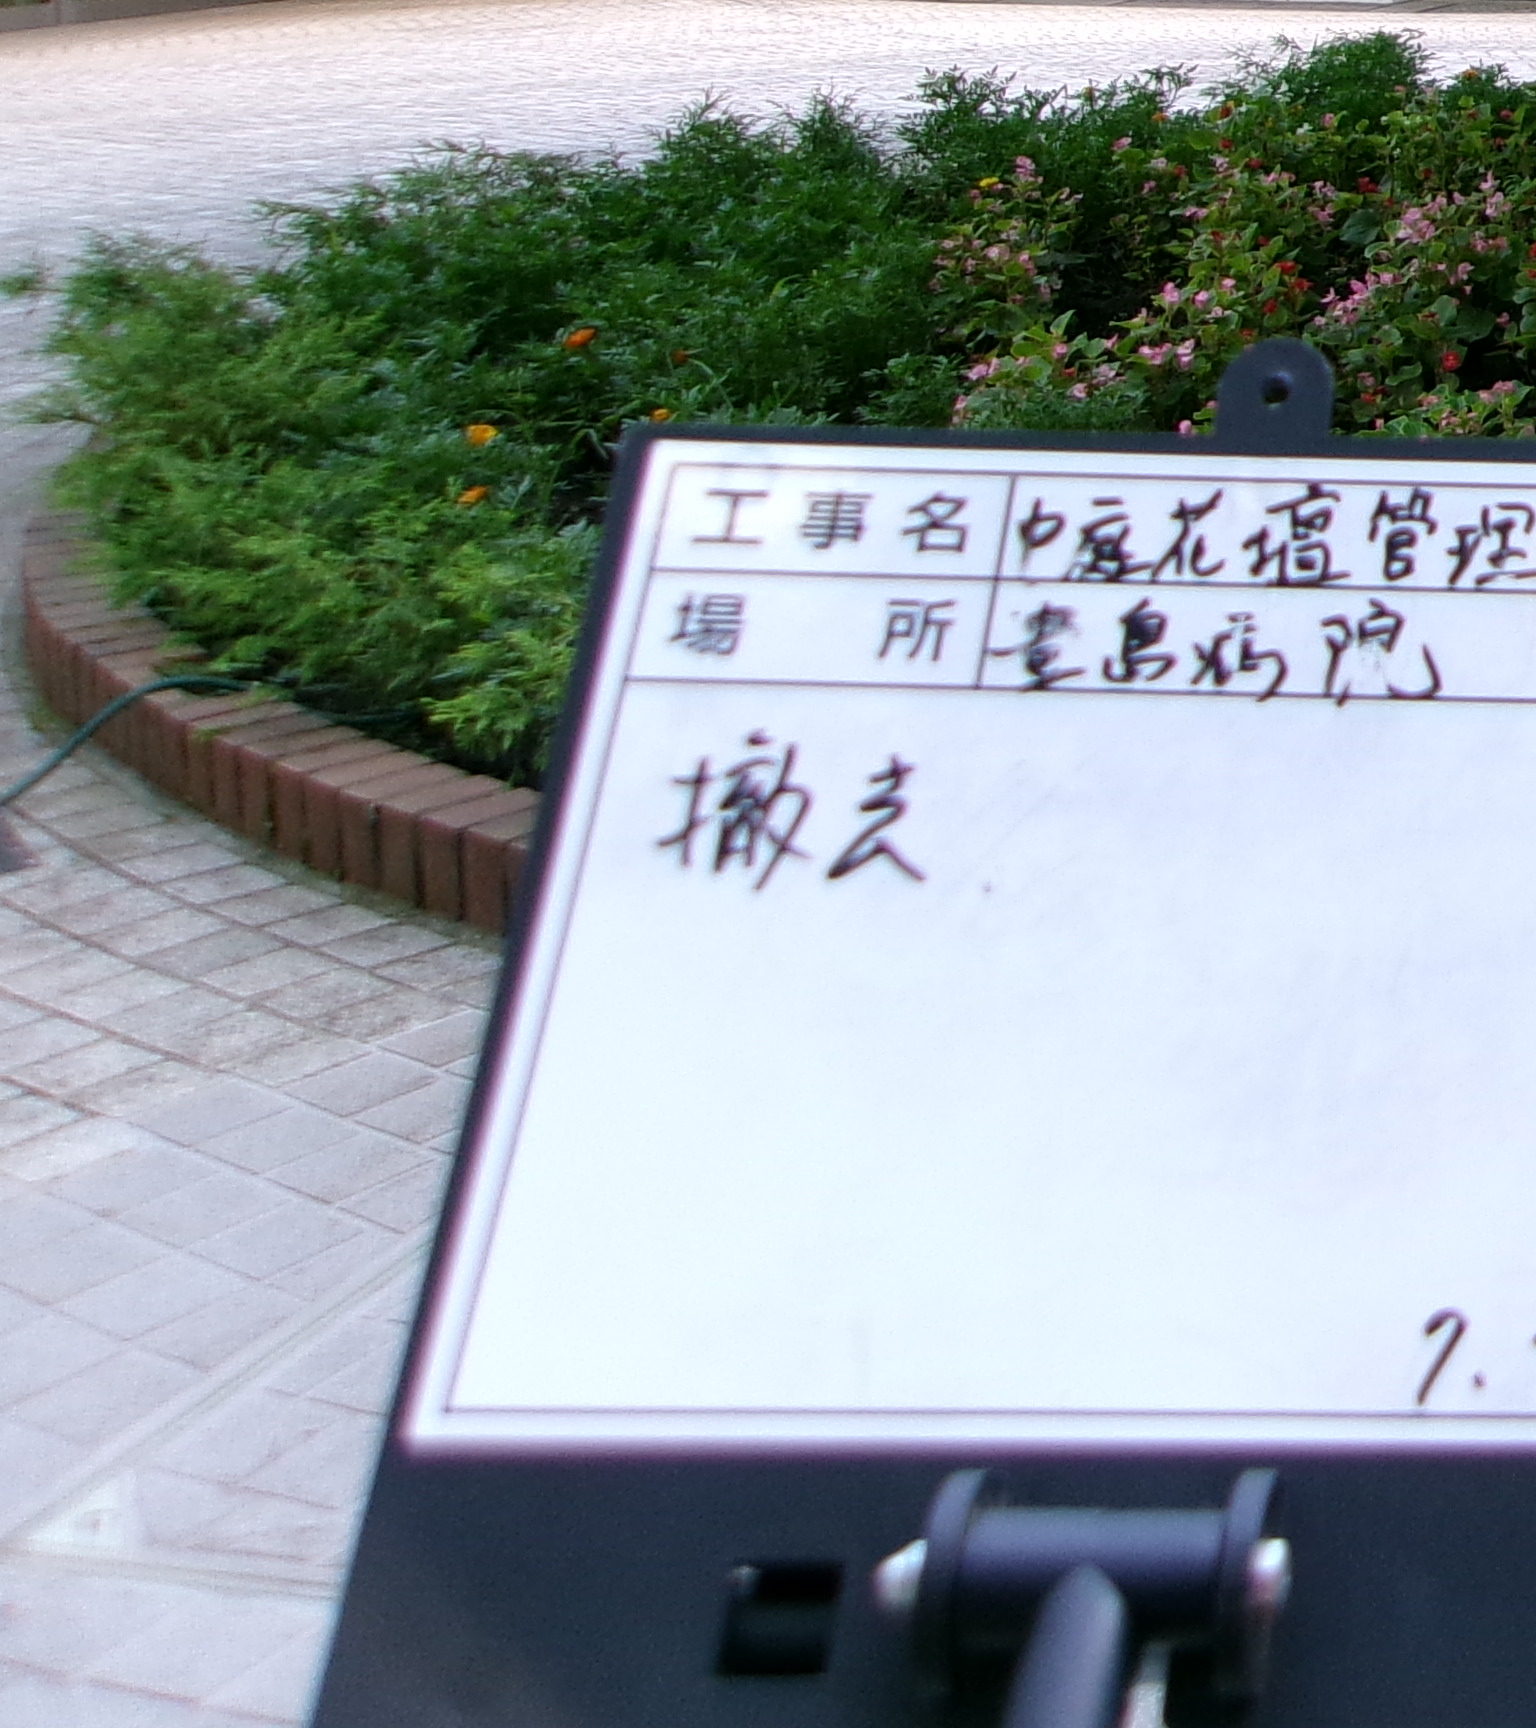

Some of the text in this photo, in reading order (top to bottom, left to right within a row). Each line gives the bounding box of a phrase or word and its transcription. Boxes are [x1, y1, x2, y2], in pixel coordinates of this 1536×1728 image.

[690, 488, 968, 553] 工事名
[669, 590, 956, 662] 場所
[990, 596, 1442, 707] 豊島病院
[656, 727, 926, 891] 撤去
